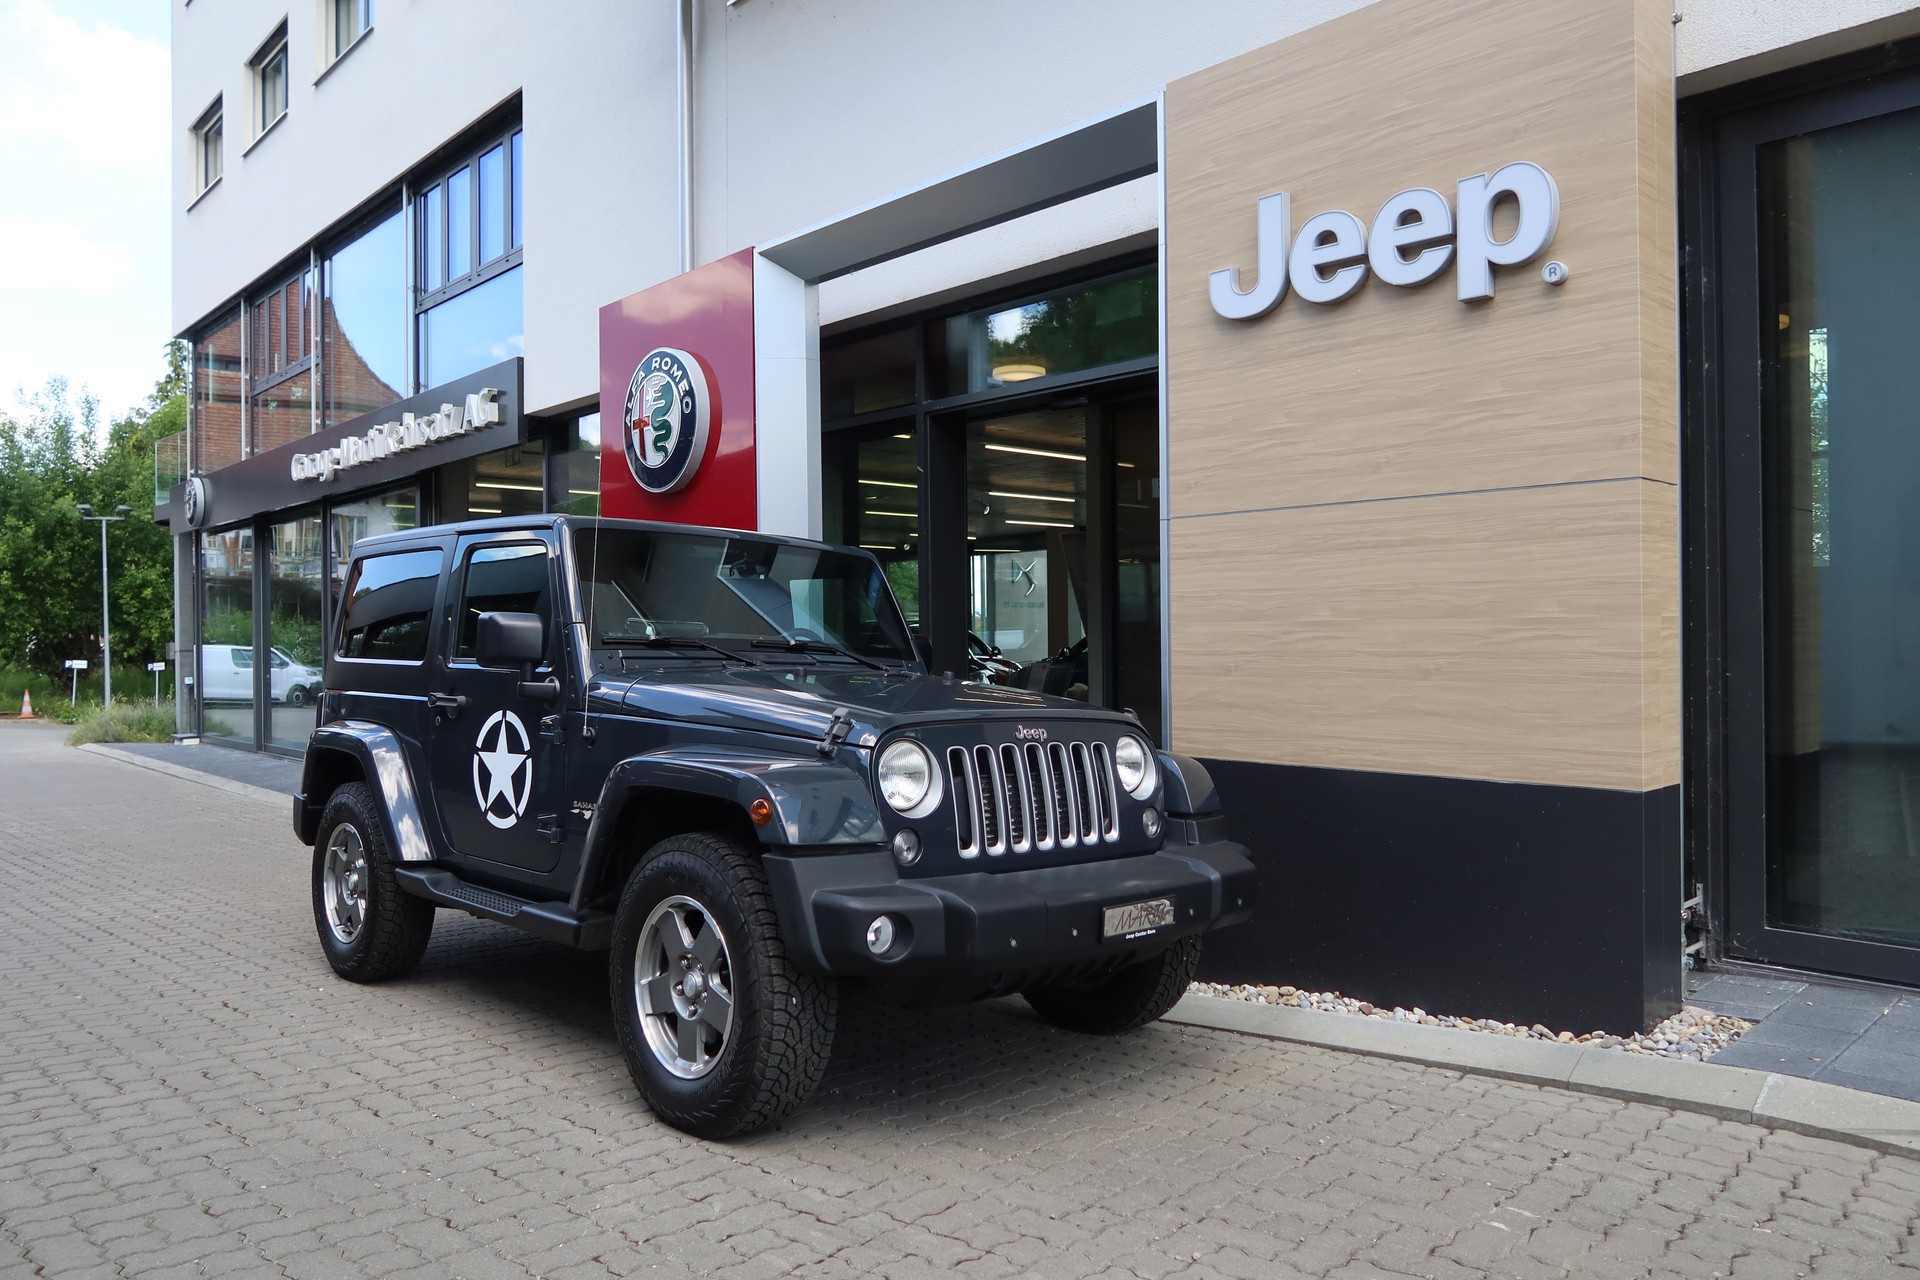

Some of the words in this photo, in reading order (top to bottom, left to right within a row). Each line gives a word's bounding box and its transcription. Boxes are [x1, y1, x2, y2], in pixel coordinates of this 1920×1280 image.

[1208, 160, 1560, 321] Jeep
[291, 453, 341, 482] Garage
[462, 387, 499, 430] AG
[625, 371, 646, 429] ALFA
[651, 356, 692, 414] ROMEO
[1014, 724, 1048, 742] Jeep
